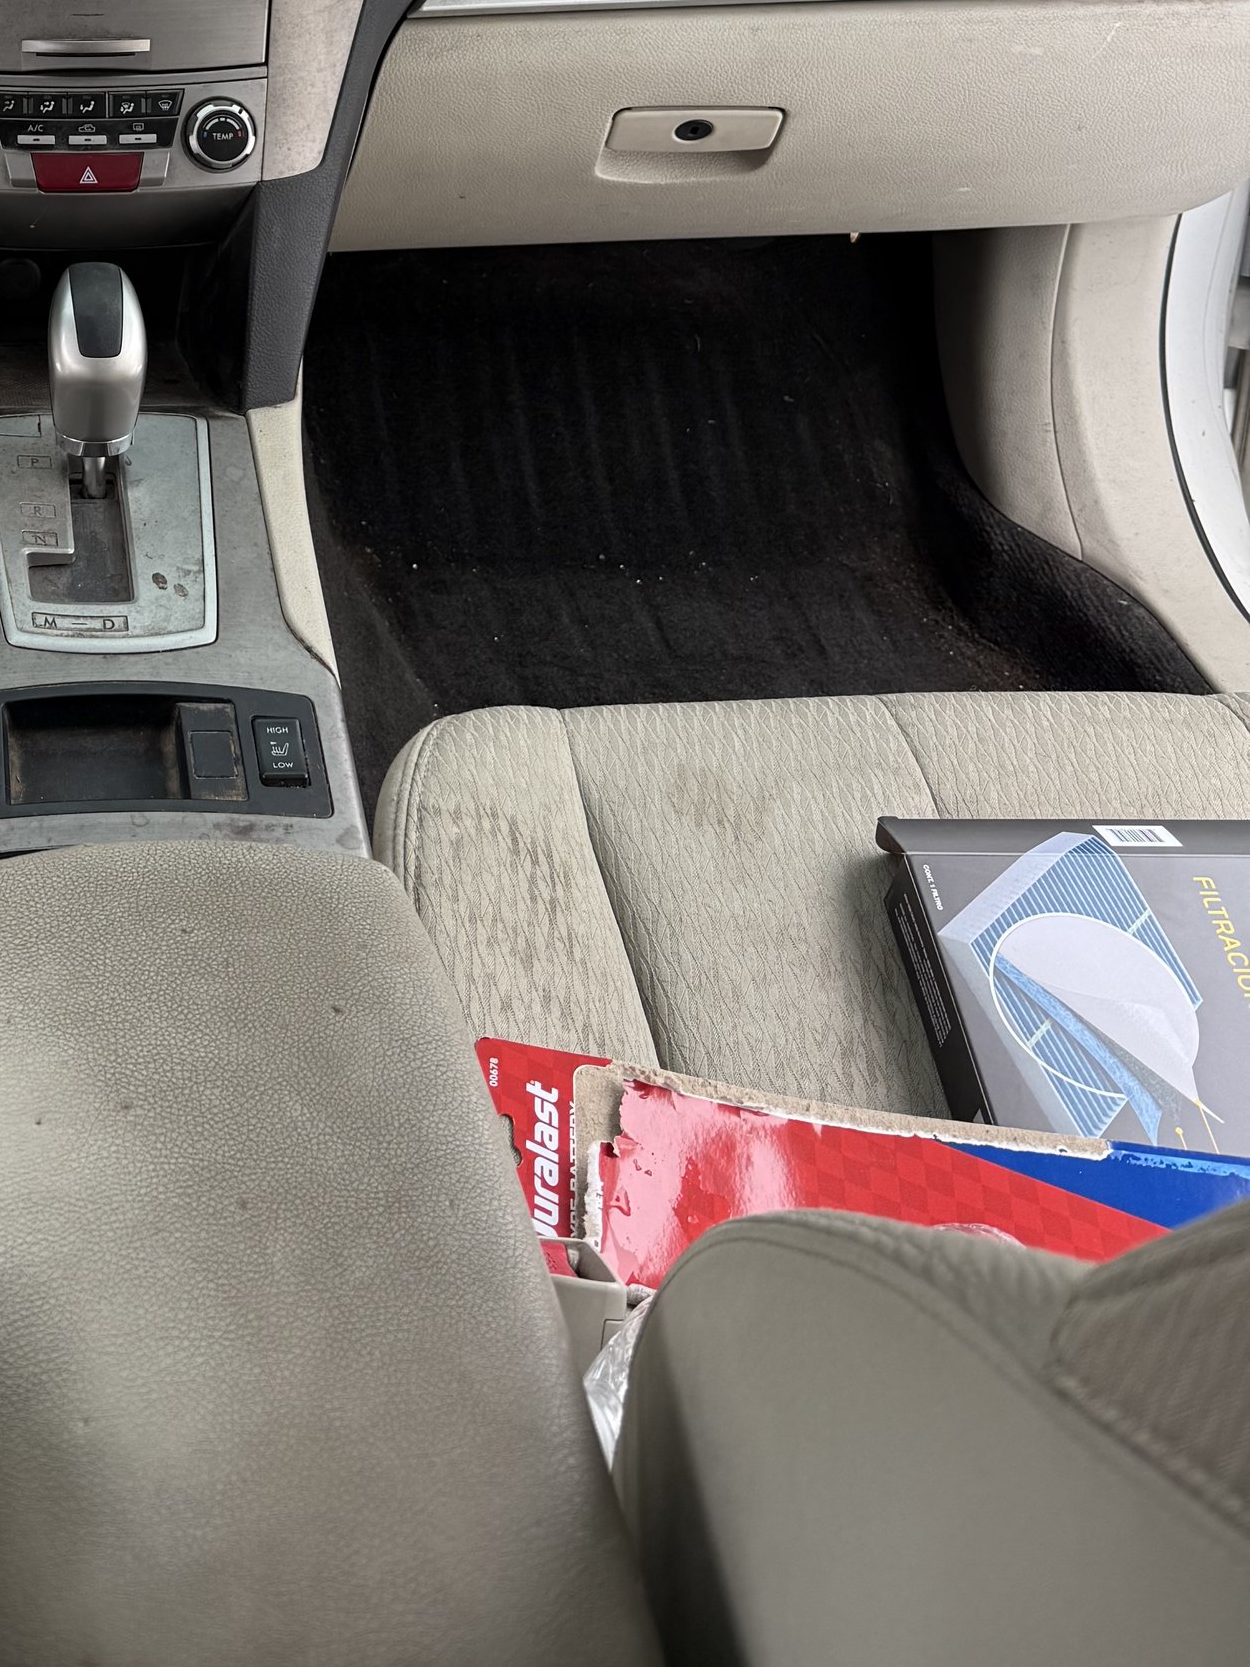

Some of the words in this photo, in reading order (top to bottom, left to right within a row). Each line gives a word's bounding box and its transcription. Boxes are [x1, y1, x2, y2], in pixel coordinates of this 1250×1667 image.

[28, 124, 44, 132] A/C
[212, 132, 234, 140] TEMP
[31, 458, 39, 467] P
[34, 506, 42, 516] R
[33, 535, 47, 544] N
[43, 616, 58, 628] M
[102, 618, 115, 630] D
[265, 726, 289, 734] HIGH
[272, 761, 294, 769] LOW
[930, 888, 944, 911] FILTRO
[1192, 875, 1250, 1012] FILTRACIO
[489, 1057, 499, 1087] 00678
